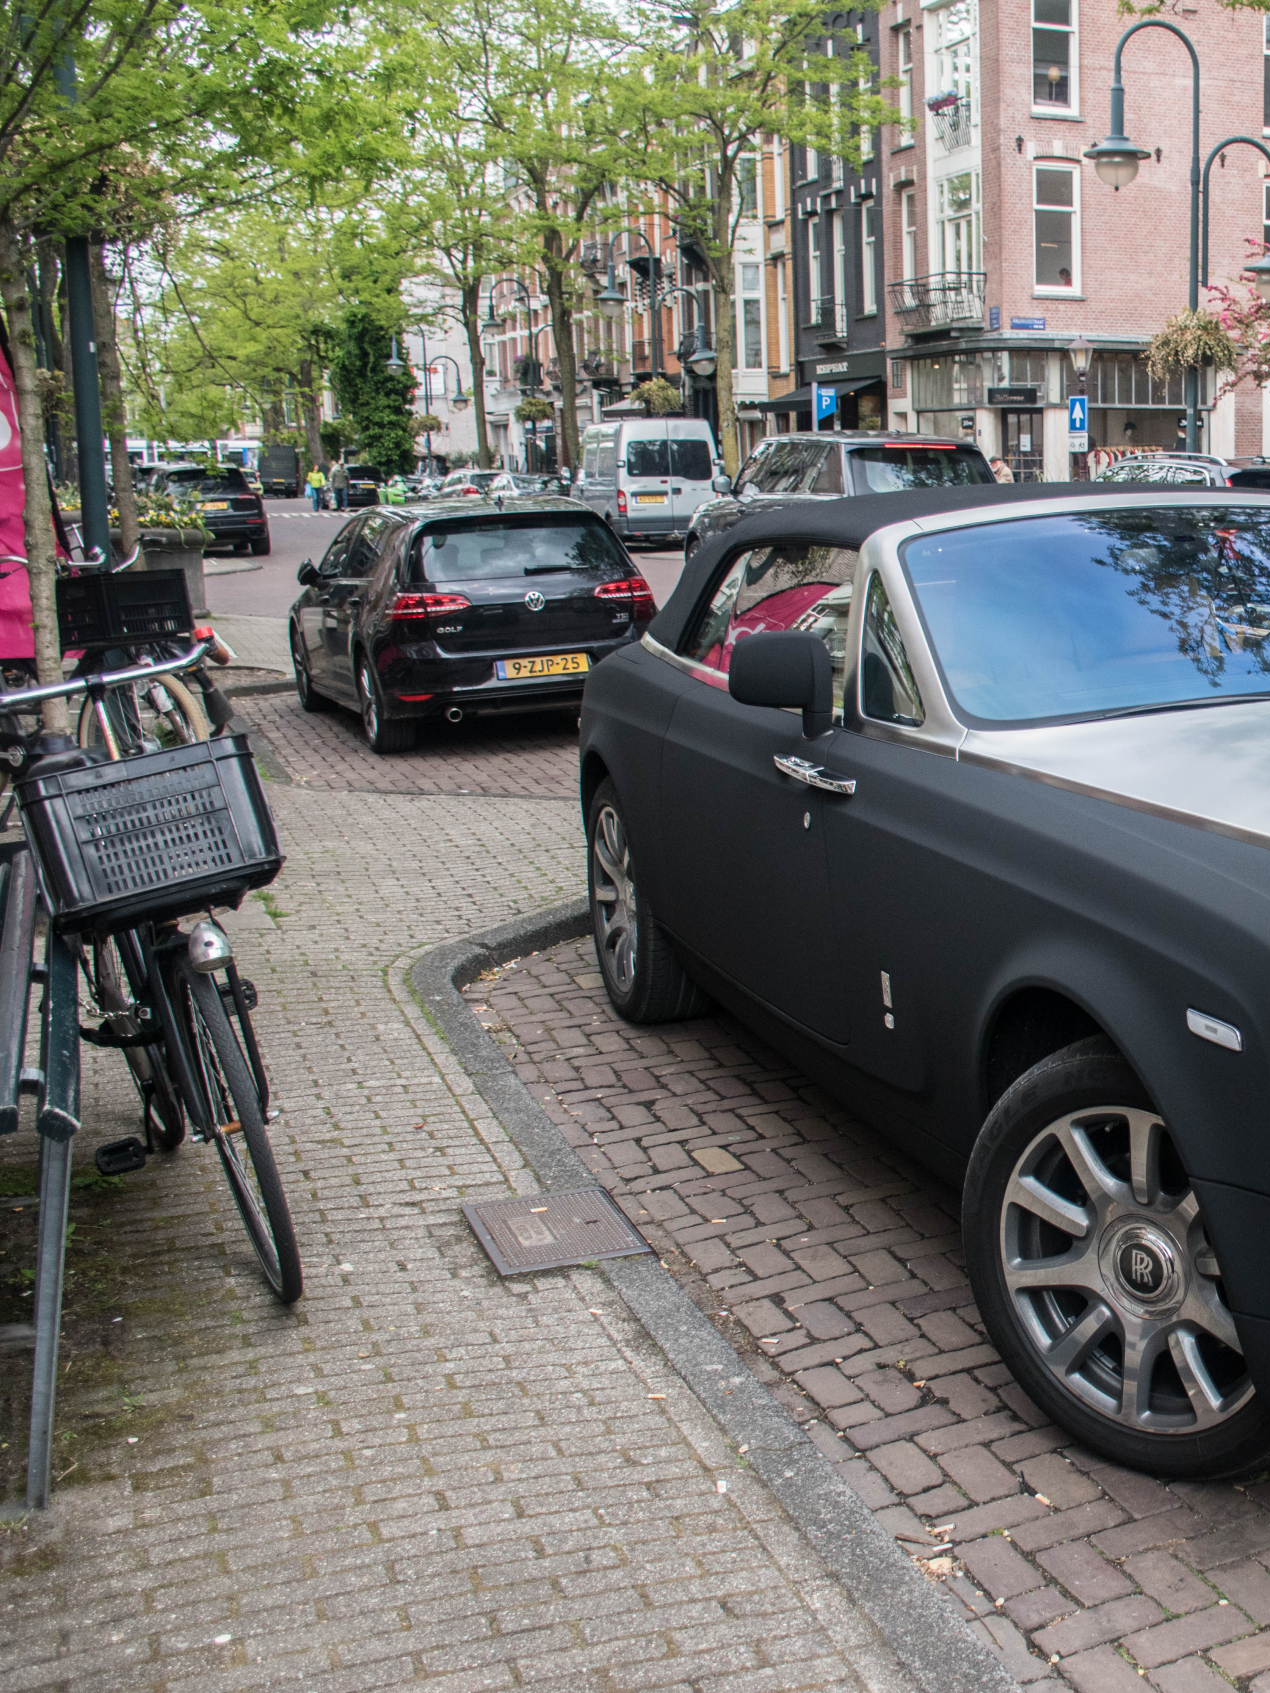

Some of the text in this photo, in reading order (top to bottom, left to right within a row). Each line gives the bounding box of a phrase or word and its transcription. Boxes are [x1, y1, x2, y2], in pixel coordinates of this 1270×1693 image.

[822, 396, 831, 409] P
[436, 626, 463, 634] GOLF
[512, 656, 580, 675] 9-ZJP-25
